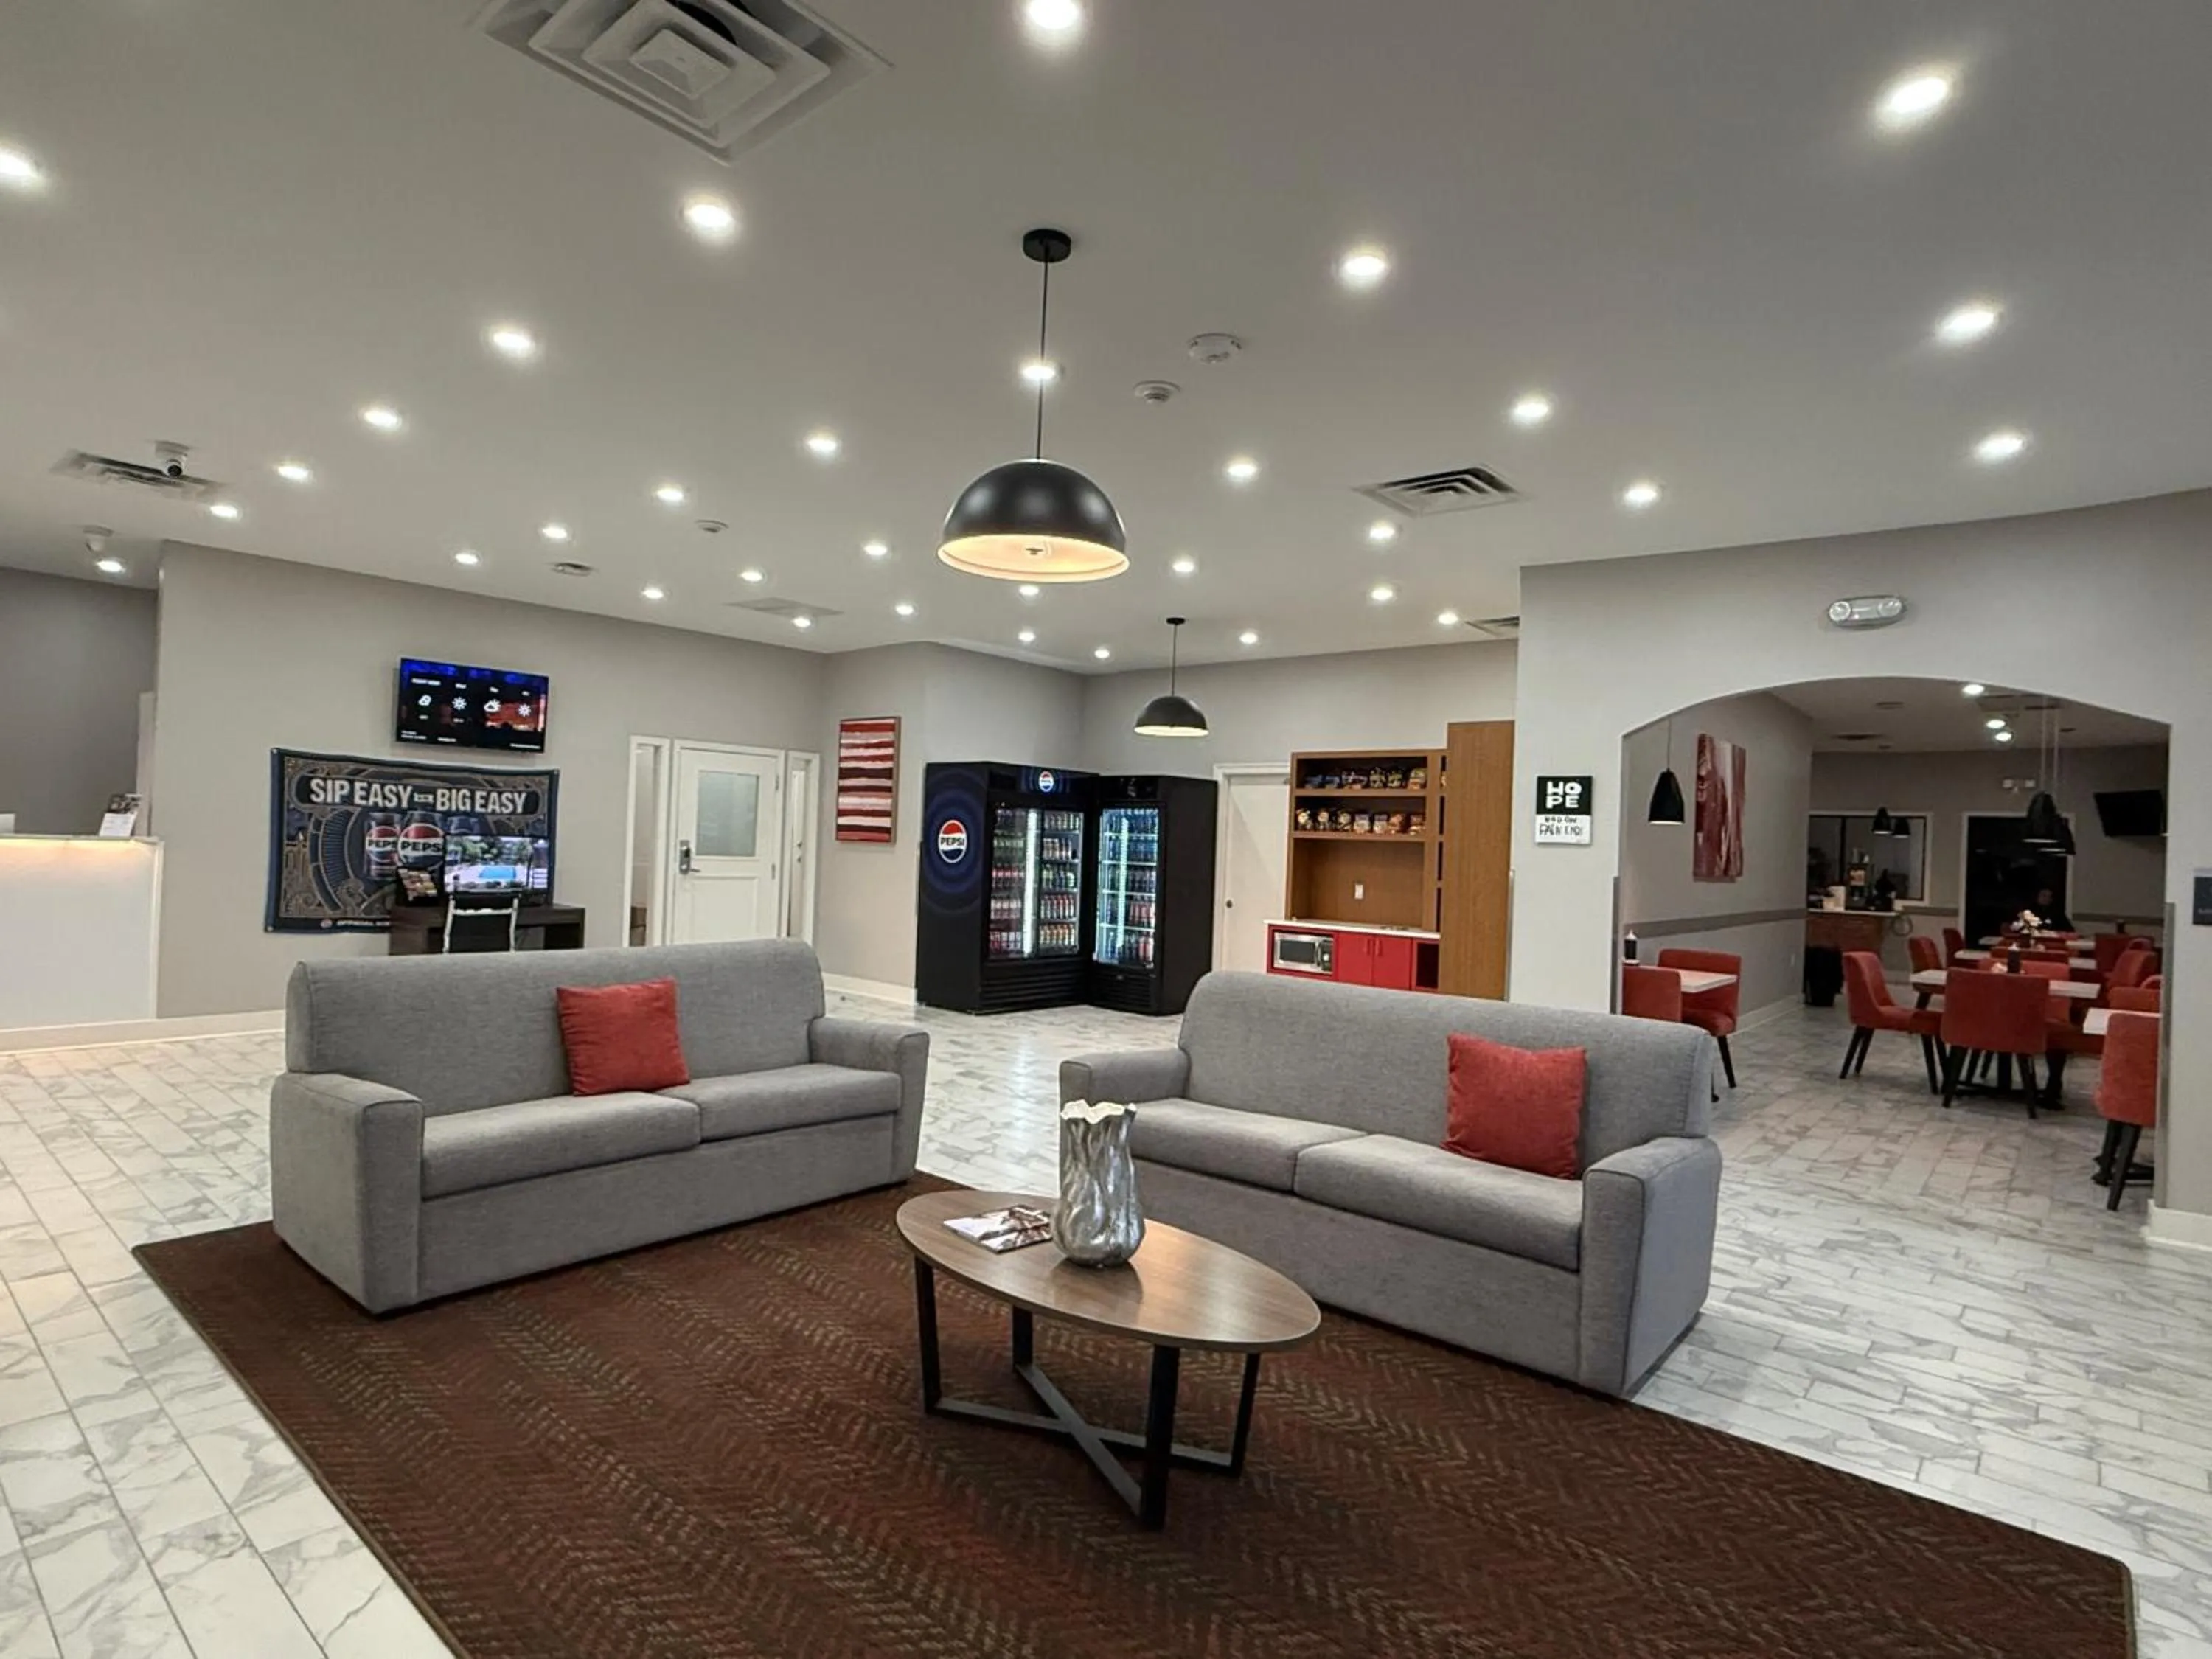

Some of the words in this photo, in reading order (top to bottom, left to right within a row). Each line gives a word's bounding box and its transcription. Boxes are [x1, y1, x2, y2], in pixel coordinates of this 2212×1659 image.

[310, 778, 350, 804] SIP
[354, 781, 413, 809] EASY
[436, 788, 472, 811] BIG
[474, 790, 527, 814] EASY
[400, 840, 442, 853] PEPS
[940, 837, 965, 846] PEPSI
